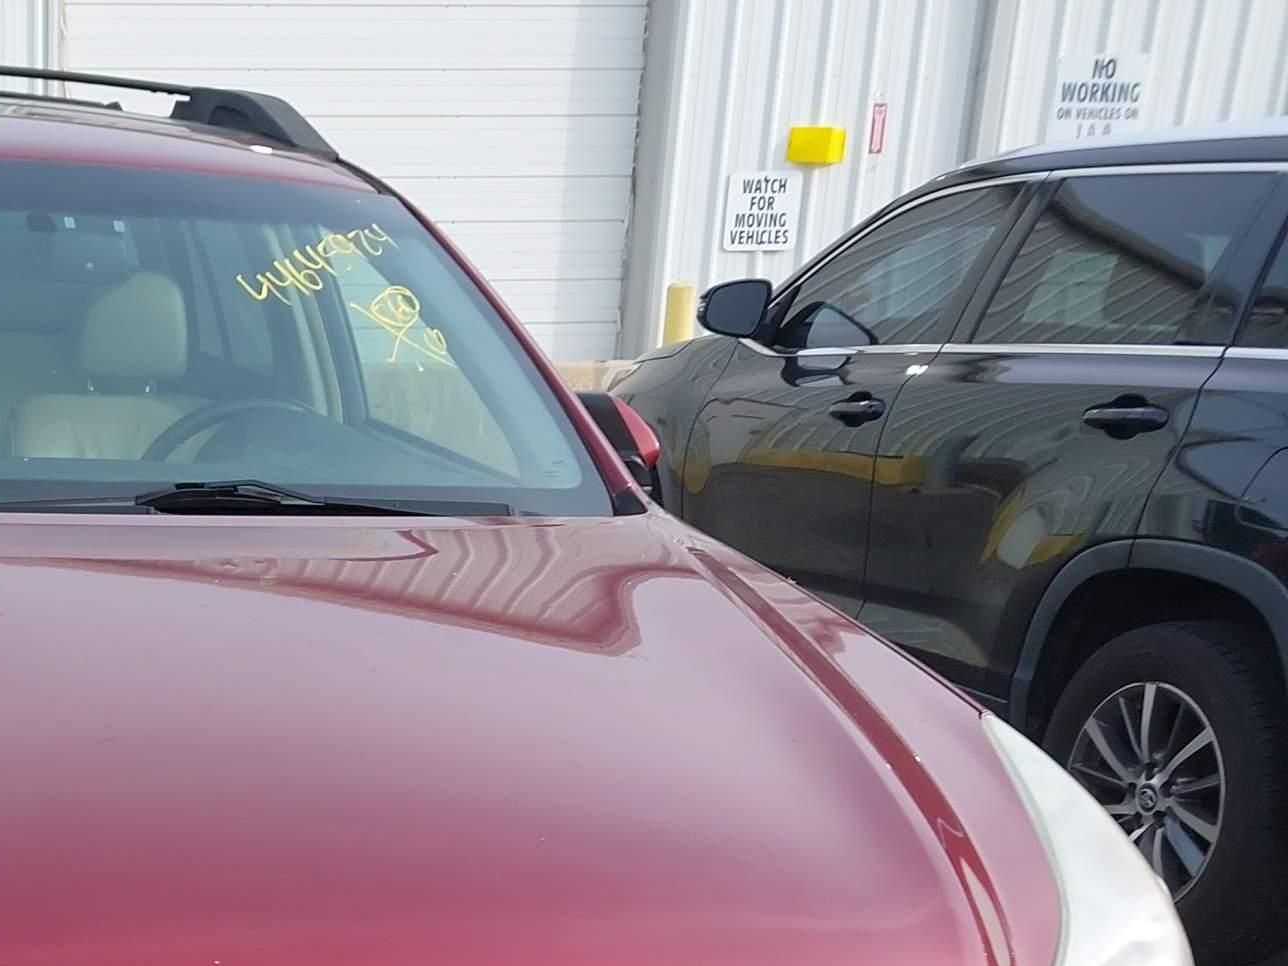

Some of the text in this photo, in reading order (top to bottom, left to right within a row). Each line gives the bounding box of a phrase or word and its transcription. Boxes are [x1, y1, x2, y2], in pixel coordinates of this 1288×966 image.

[1091, 58, 1117, 79] NO
[1061, 82, 1142, 103] WORKING
[1056, 106, 1139, 120] ON VEHICLES ON
[742, 178, 788, 194] WATCH
[749, 196, 775, 211] FOR
[734, 212, 787, 228] MOVING
[730, 229, 789, 245] VEHICLES
